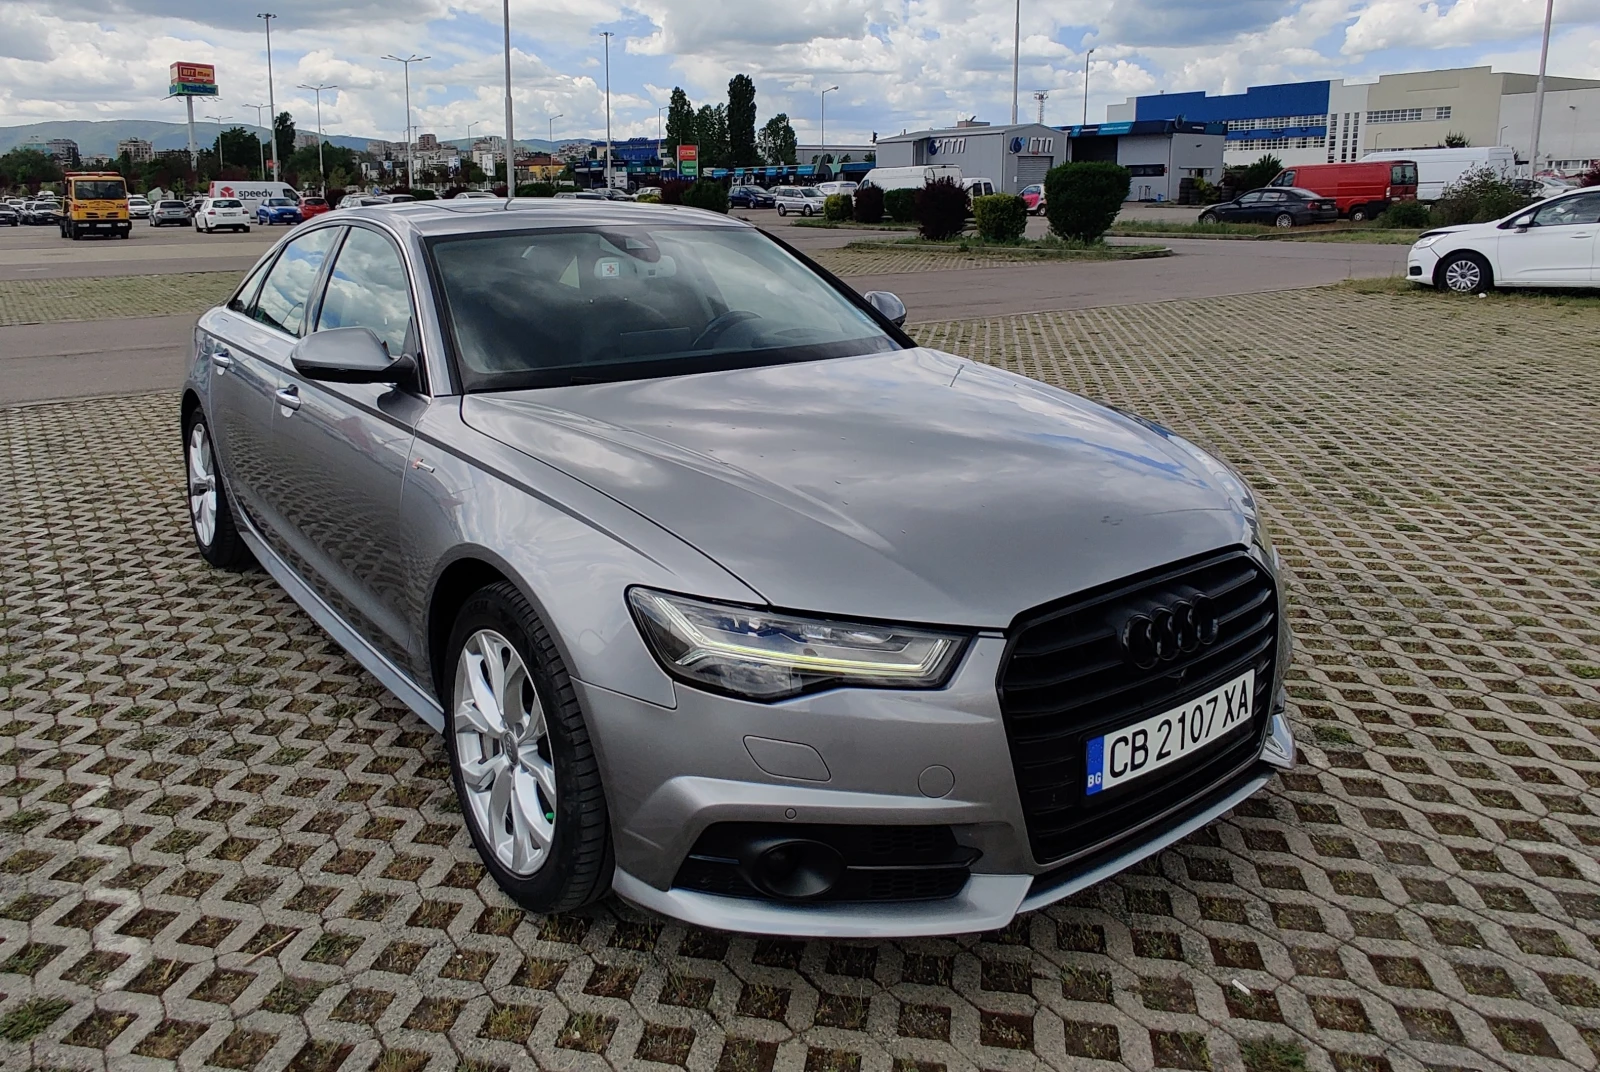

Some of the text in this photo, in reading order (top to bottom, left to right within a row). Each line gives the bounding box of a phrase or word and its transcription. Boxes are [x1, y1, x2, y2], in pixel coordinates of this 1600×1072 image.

[1109, 680, 1250, 779] CB 2107 XA
[1086, 771, 1102, 788] BG
